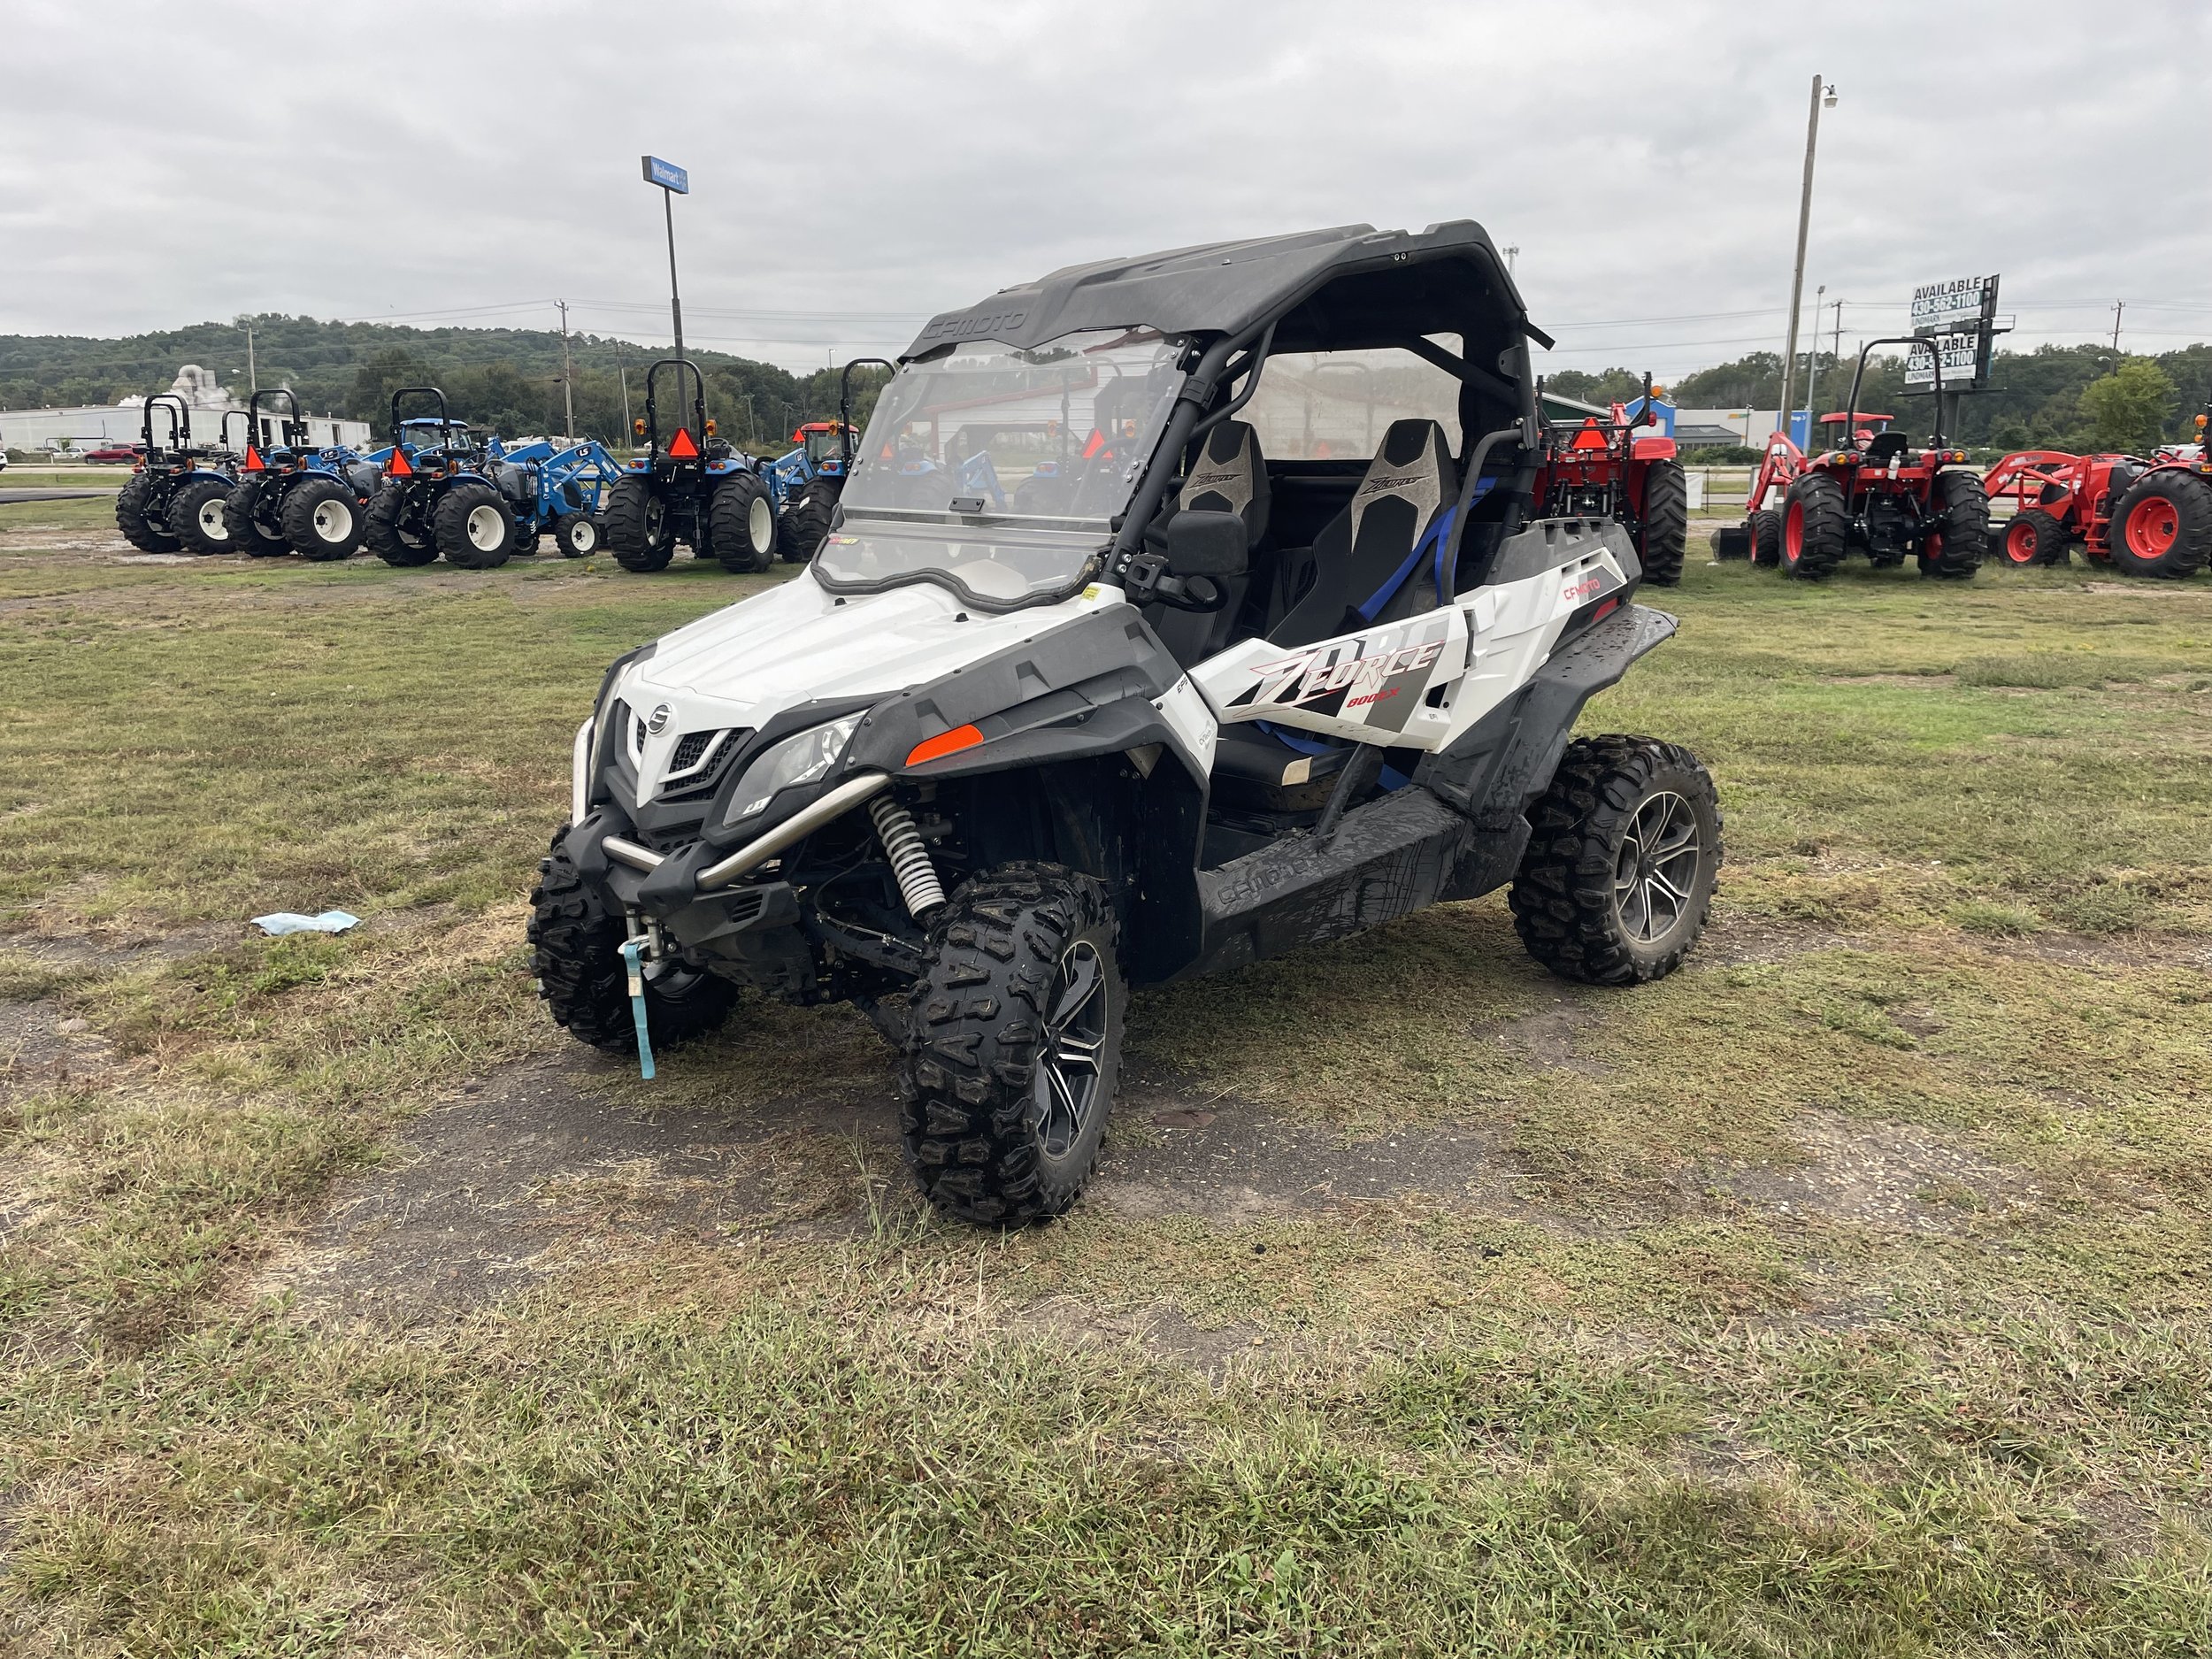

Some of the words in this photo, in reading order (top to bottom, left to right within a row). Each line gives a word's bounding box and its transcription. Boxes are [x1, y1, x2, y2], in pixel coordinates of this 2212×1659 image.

[652, 162, 679, 185] Walmart
[1914, 276, 1981, 300] AVAILABLE
[1912, 291, 1980, 316] 430-562-1100
[923, 311, 1028, 339] CFMOTO
[1909, 335, 1974, 356] AVALABLE
[1907, 350, 1974, 371] 430-52-1100
[580, 448, 588, 457] LS
[1563, 578, 1601, 601] CFMOTO
[1177, 677, 1188, 694] EPS
[1347, 687, 1401, 708] 800EX
